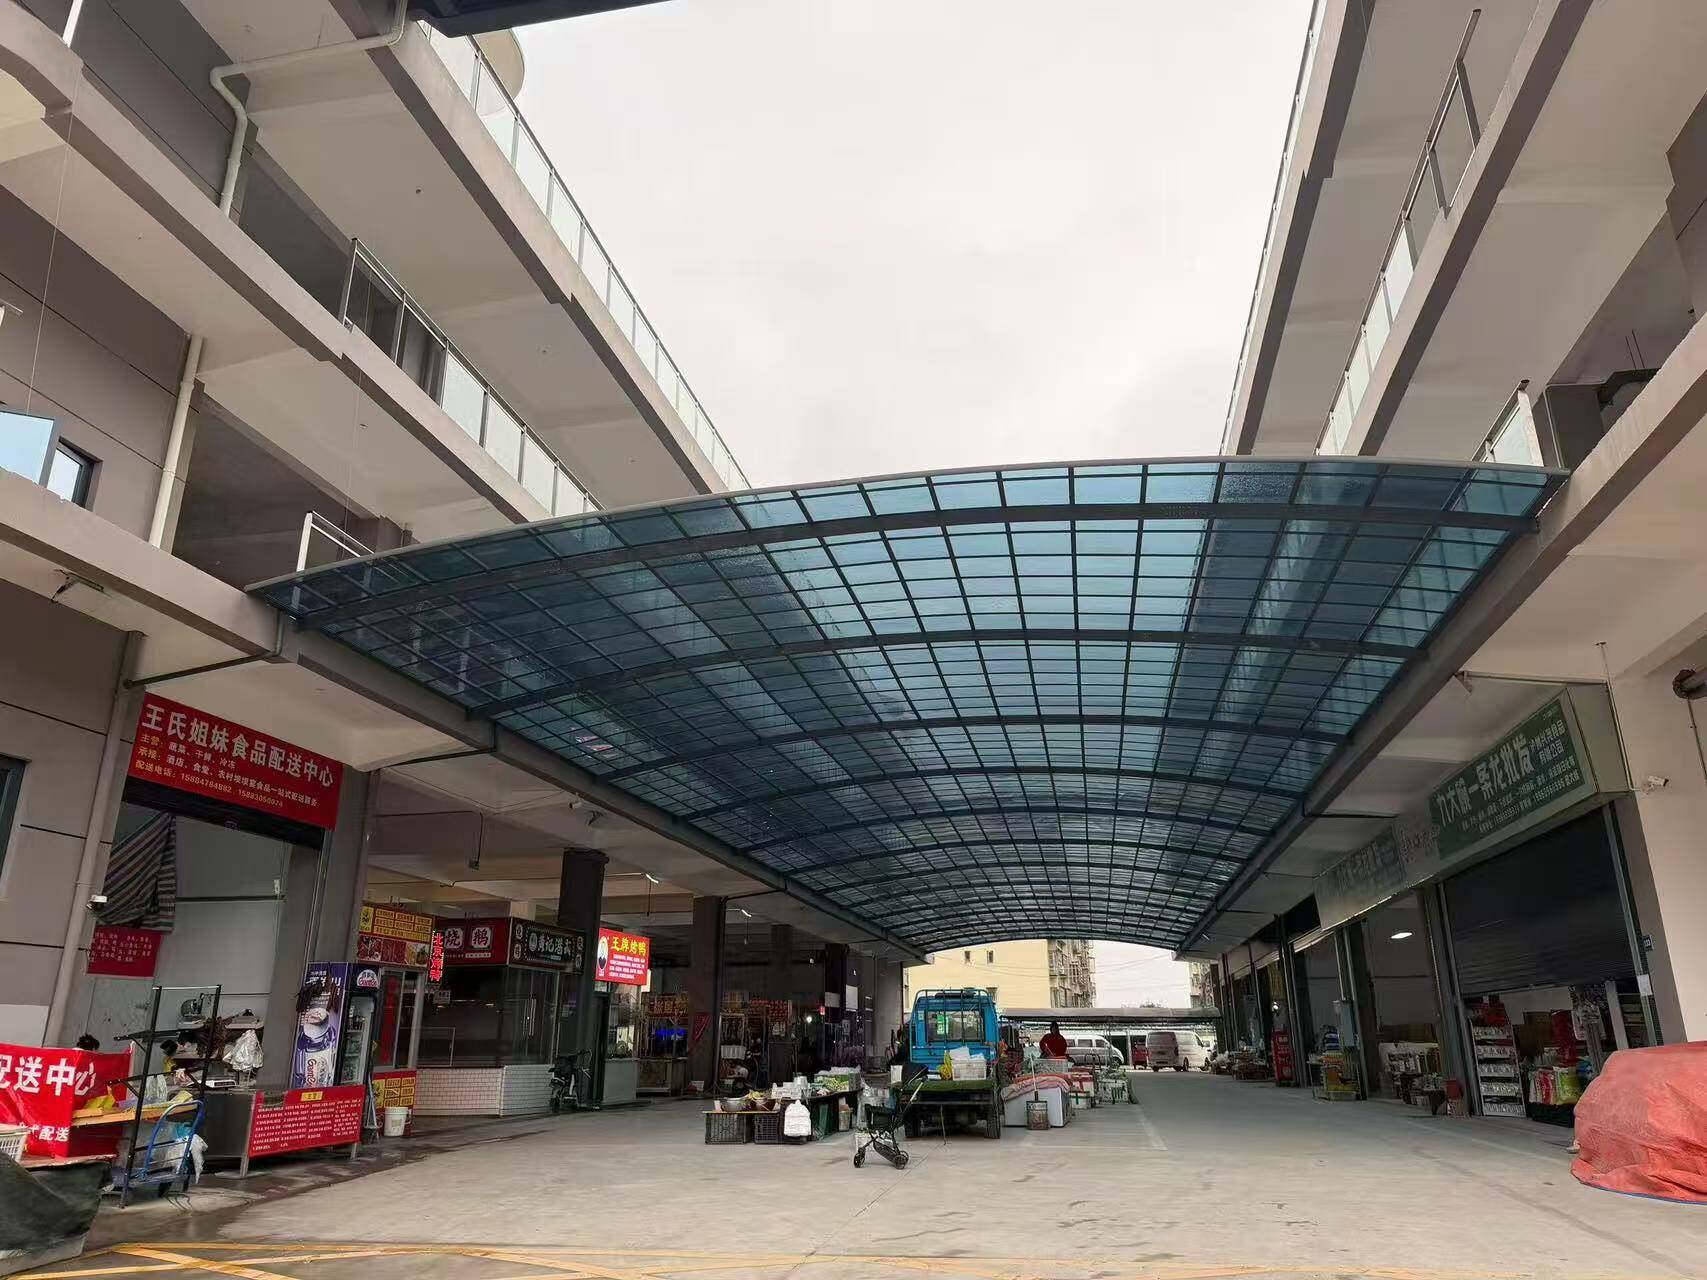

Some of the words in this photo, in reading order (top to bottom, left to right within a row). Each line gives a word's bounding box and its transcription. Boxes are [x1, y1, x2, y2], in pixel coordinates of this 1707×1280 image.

[141, 704, 334, 788] 王氏姐妹食品配送中心
